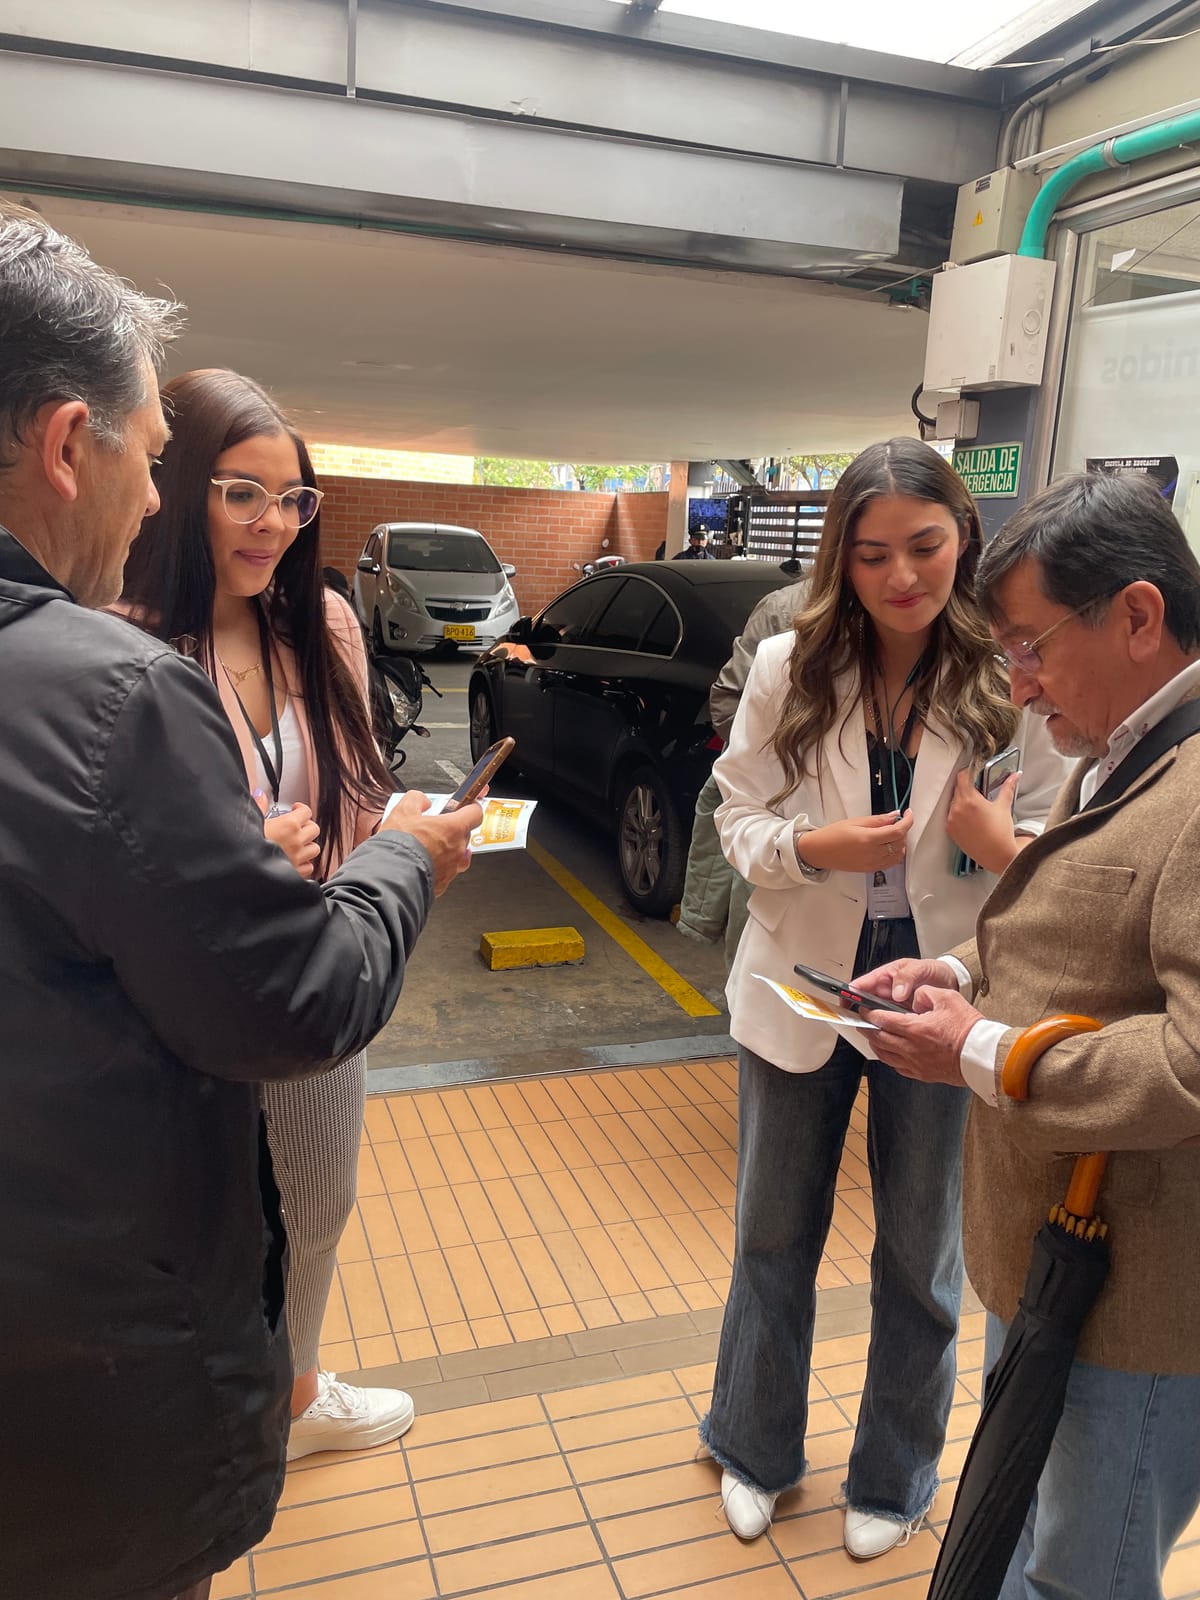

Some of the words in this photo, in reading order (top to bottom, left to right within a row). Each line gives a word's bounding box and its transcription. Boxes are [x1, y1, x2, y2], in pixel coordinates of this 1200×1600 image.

[956, 449, 996, 474] SALIDA
[999, 448, 1017, 471] DE
[961, 472, 1013, 492] MERGENCIA
